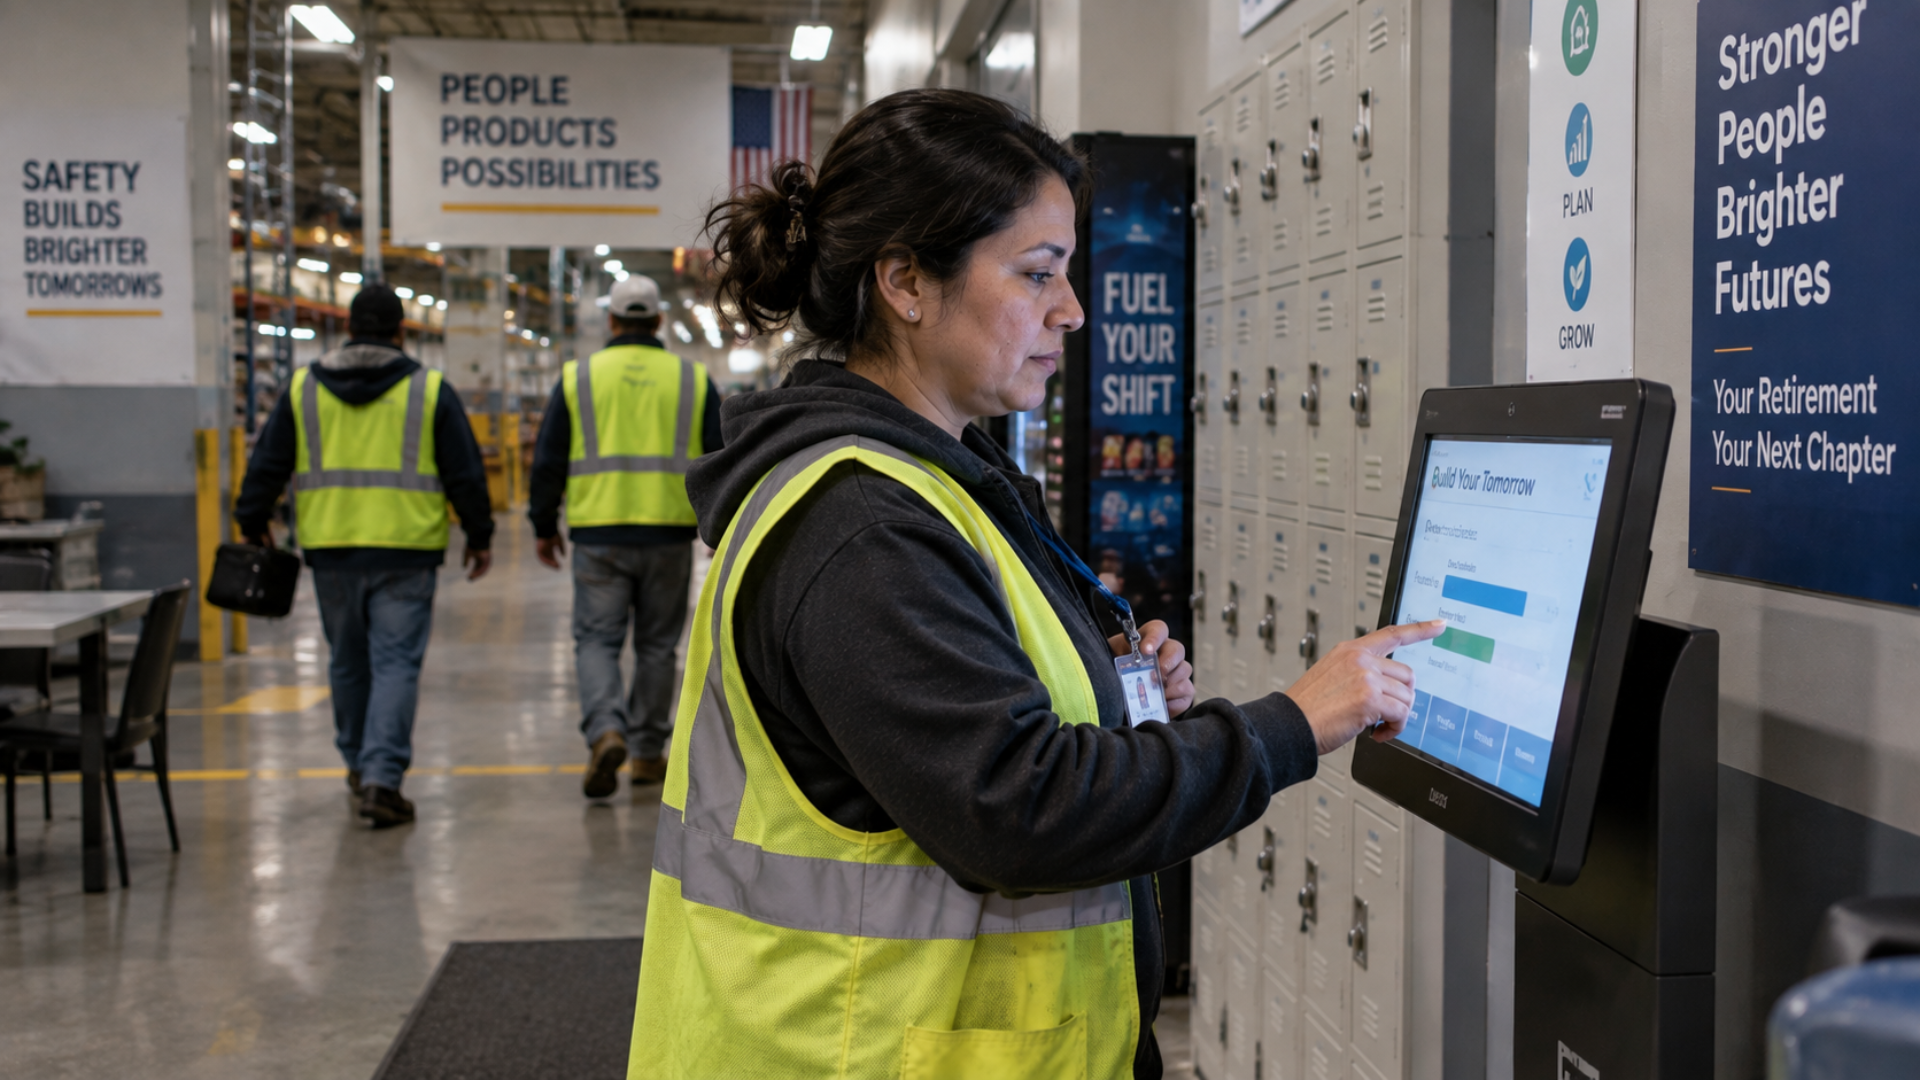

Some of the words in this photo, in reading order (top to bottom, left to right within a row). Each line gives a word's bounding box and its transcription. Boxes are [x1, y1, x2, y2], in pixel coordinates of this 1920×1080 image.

[1718, 0, 1867, 91] Stronger
[441, 73, 570, 105] PEOPLE
[441, 115, 617, 148] PRODUCTS
[1718, 84, 1827, 165] People
[23, 160, 141, 193] SAFETY
[441, 157, 661, 190] POSSIBILITIES
[24, 200, 122, 229] BUILDS
[1563, 187, 1594, 219] PLAN
[1716, 171, 1844, 247] Brighter
[24, 236, 147, 264] BRIGHTER
[24, 271, 163, 299] TOMORROWS
[1104, 271, 1175, 315] FUEL
[1715, 260, 1831, 315] Futures
[1102, 322, 1176, 364] YOUR
[1558, 323, 1595, 350] GROW
[1101, 374, 1176, 415] SHIFT
[1713, 378, 1754, 414] Your
[1758, 374, 1878, 415] Retirement
[1712, 430, 1753, 467] Your
[1757, 431, 1802, 470] Next
[1807, 431, 1896, 484] Chapter
[1458, 468, 1481, 491] Your
[1482, 470, 1536, 497] Tomorrow
